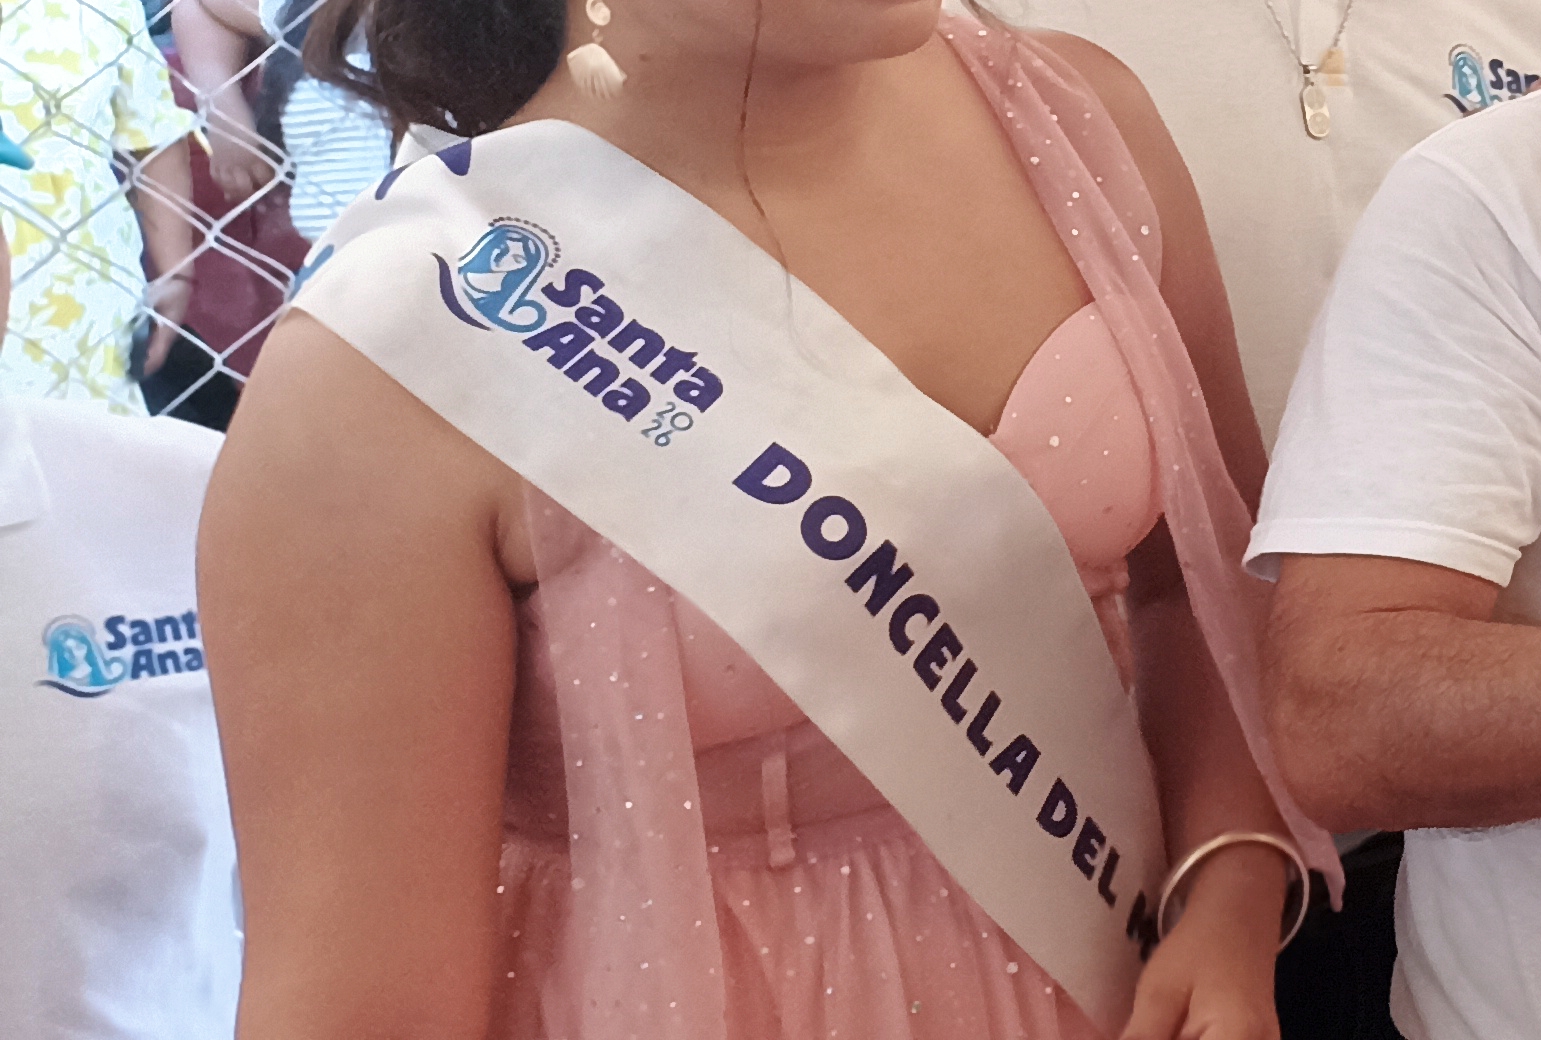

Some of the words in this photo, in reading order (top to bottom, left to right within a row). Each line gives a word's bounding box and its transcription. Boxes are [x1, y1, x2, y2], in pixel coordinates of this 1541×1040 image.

[521, 320, 652, 423] Ana
[541, 268, 724, 414] Santa
[655, 401, 694, 432] 20
[103, 609, 198, 651] Sant
[130, 646, 205, 681] Ana
[731, 441, 1043, 796] DONCELLA
[1035, 777, 1121, 910] DEL
